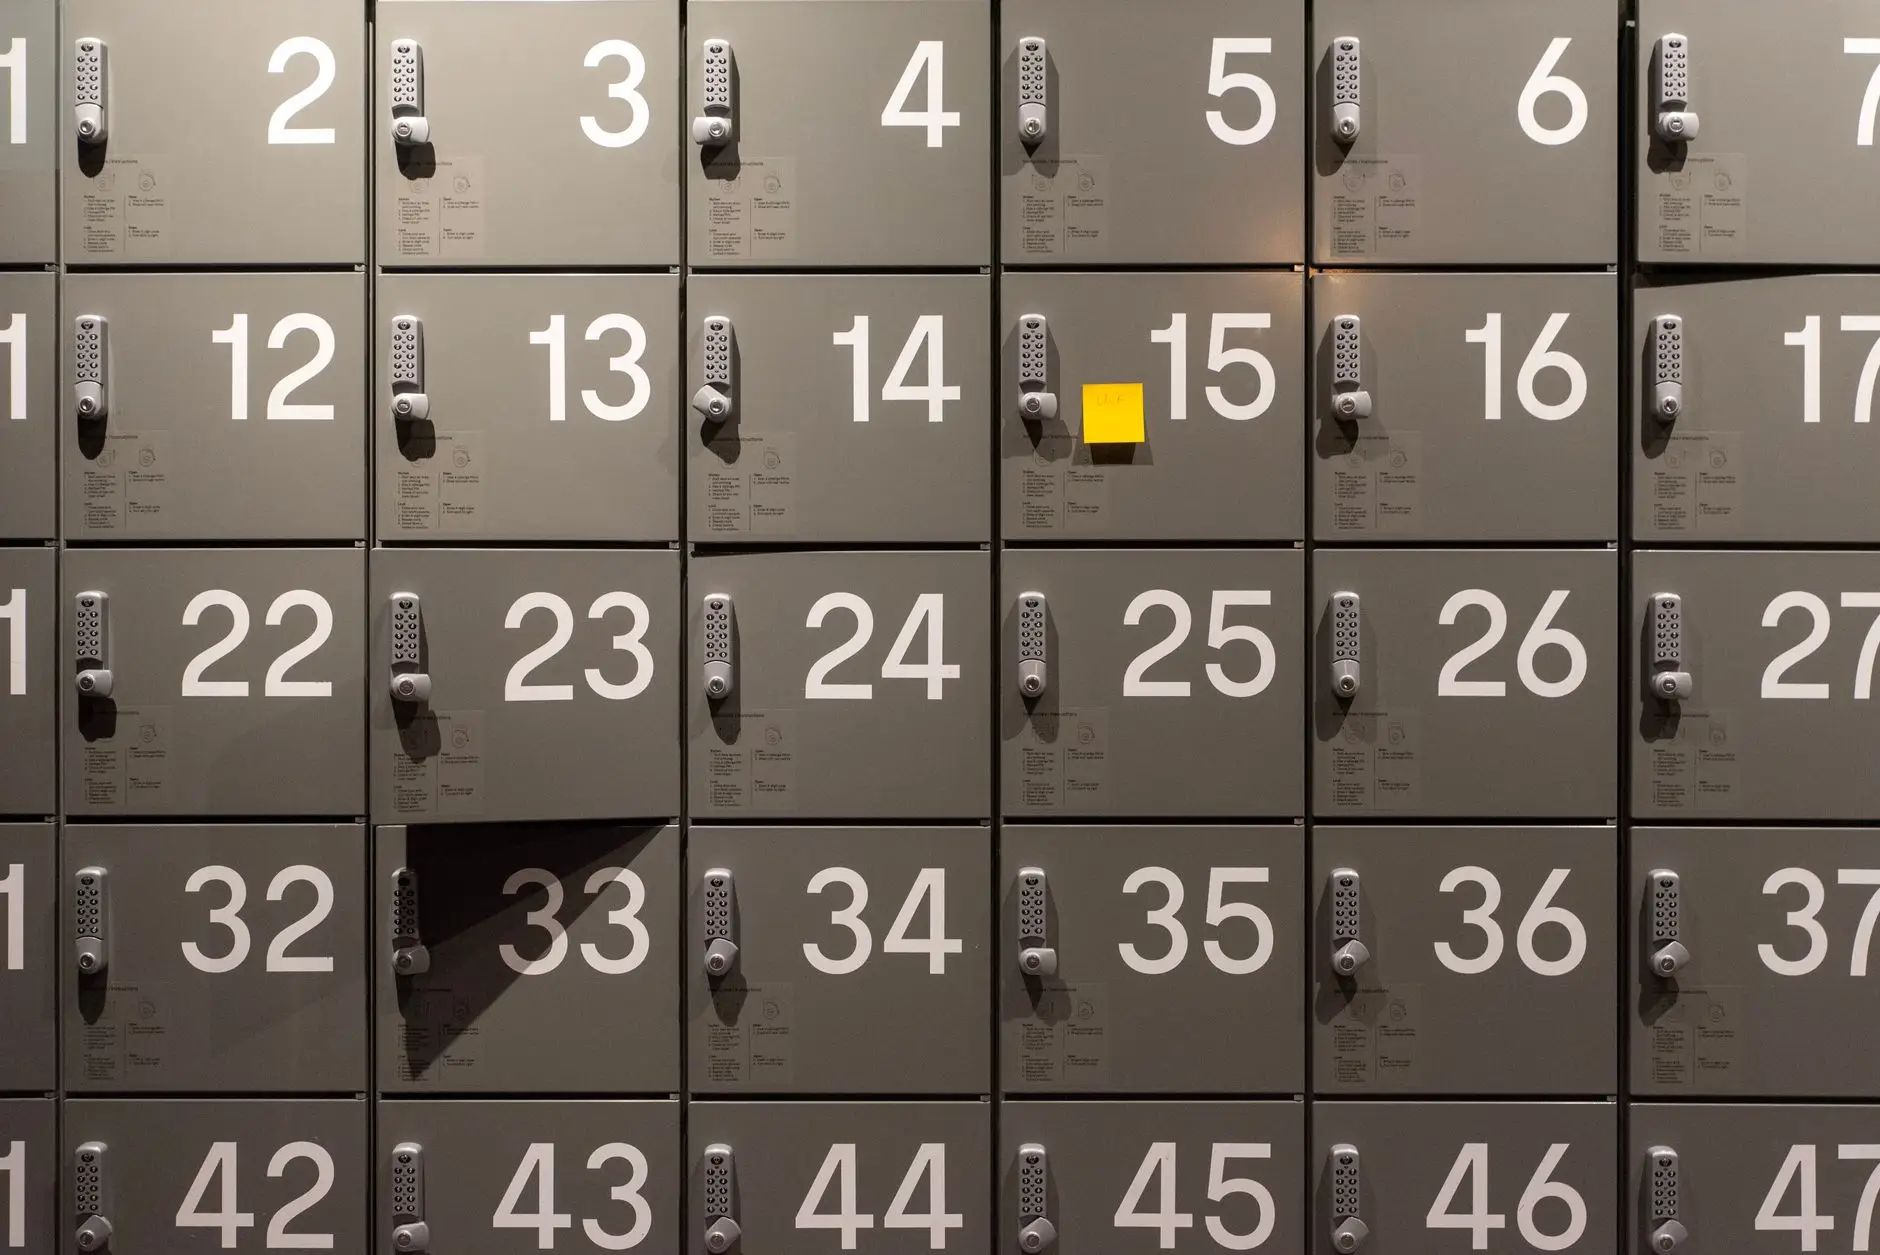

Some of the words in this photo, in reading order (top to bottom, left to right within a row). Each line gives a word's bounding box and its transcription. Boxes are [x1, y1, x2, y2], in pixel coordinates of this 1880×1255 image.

[267, 37, 336, 144] 2
[580, 39, 650, 147] 3
[881, 41, 960, 147] 4
[1205, 37, 1276, 145] 5
[1517, 38, 1588, 145] 6
[211, 313, 336, 421] 12
[529, 315, 651, 422] 13
[832, 315, 961, 422] 14
[1150, 313, 1276, 420] 15
[1465, 313, 1588, 420] 16
[1783, 315, 1880, 422] 17
[181, 589, 333, 697] 22
[504, 591, 653, 702] 23
[804, 592, 960, 700] 24
[1122, 588, 1275, 697] 25
[1437, 588, 1588, 697] 26
[1760, 591, 1880, 699] 27
[180, 865, 335, 974] 32
[499, 867, 650, 975] 33
[802, 867, 962, 975] 34
[1118, 867, 1274, 975] 35
[1433, 866, 1588, 976] 36
[1757, 868, 1880, 977] 37
[175, 1141, 334, 1250] 42
[492, 1143, 652, 1251] 43
[794, 1143, 964, 1250] 44
[1113, 1142, 1276, 1250] 45
[1425, 1143, 1588, 1250] 46
[1754, 1144, 1880, 1252] 47
